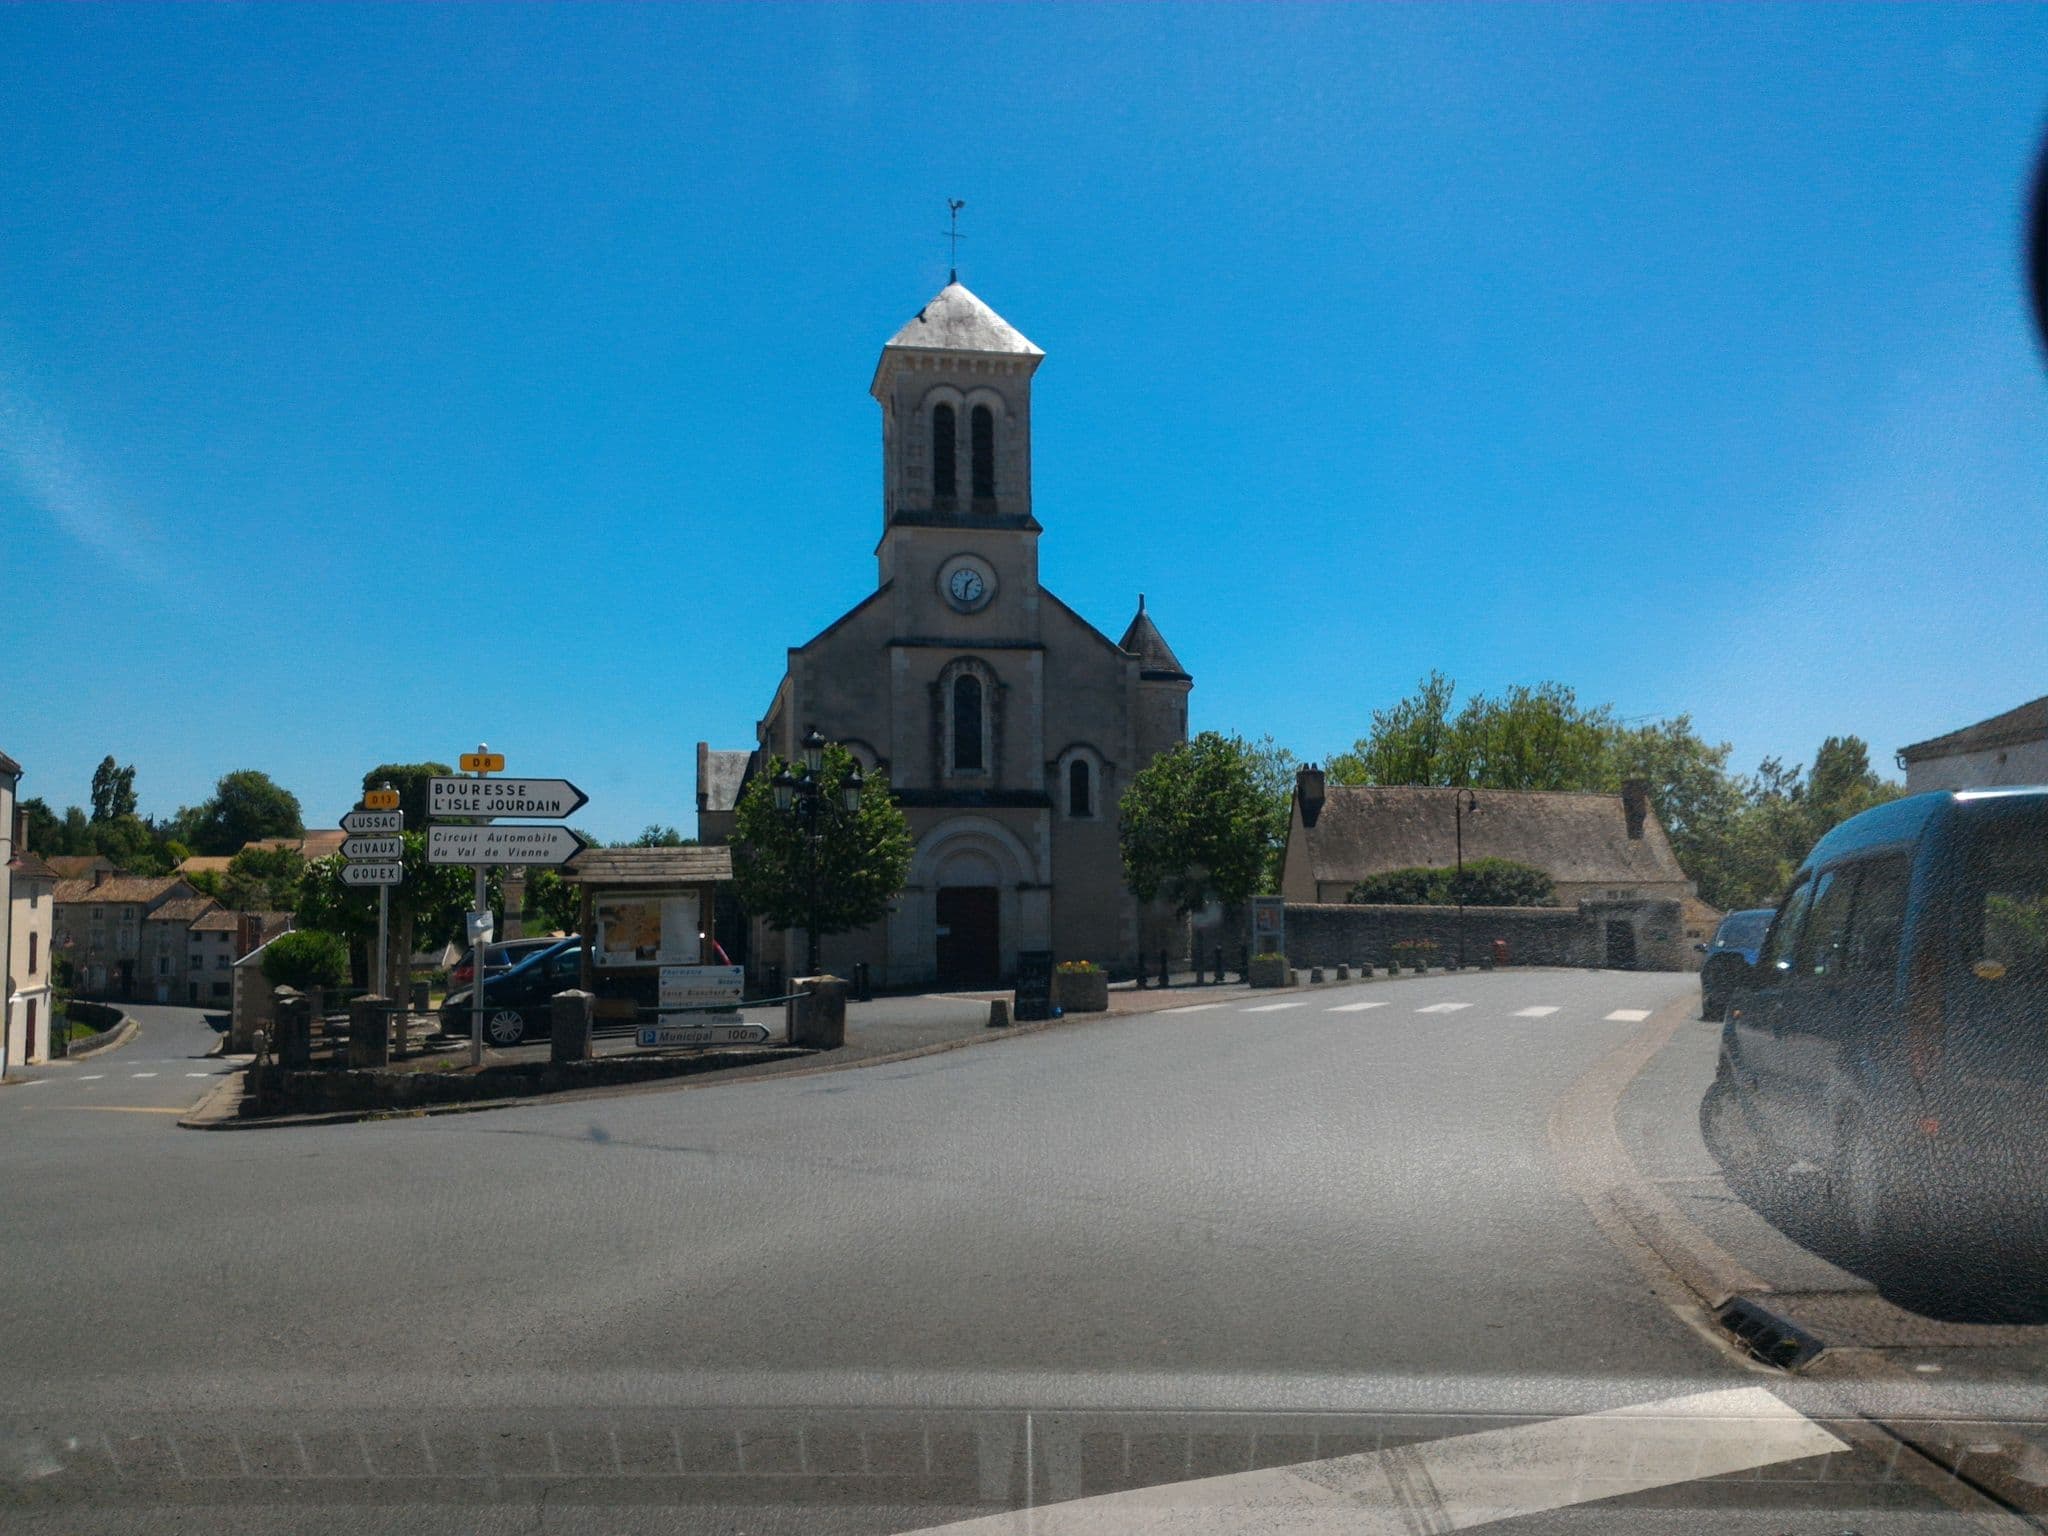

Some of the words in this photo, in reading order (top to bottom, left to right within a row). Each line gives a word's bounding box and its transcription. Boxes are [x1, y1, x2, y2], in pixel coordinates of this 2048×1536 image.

[472, 757, 480, 768] D
[484, 757, 492, 768] 8
[434, 783, 527, 797] BOURESSE
[434, 798, 480, 811] L'ISLE
[486, 799, 561, 812] JOURDAIN
[351, 816, 396, 829] LUSSAC
[433, 831, 478, 843] Circuit
[486, 832, 558, 844] Automobile
[351, 841, 396, 854] CIVAUX
[433, 848, 448, 857] du
[457, 847, 476, 857] Val
[484, 847, 499, 858] de
[508, 847, 550, 858] Vienne
[352, 867, 396, 880] GOUEX
[660, 1030, 713, 1043] Municipal
